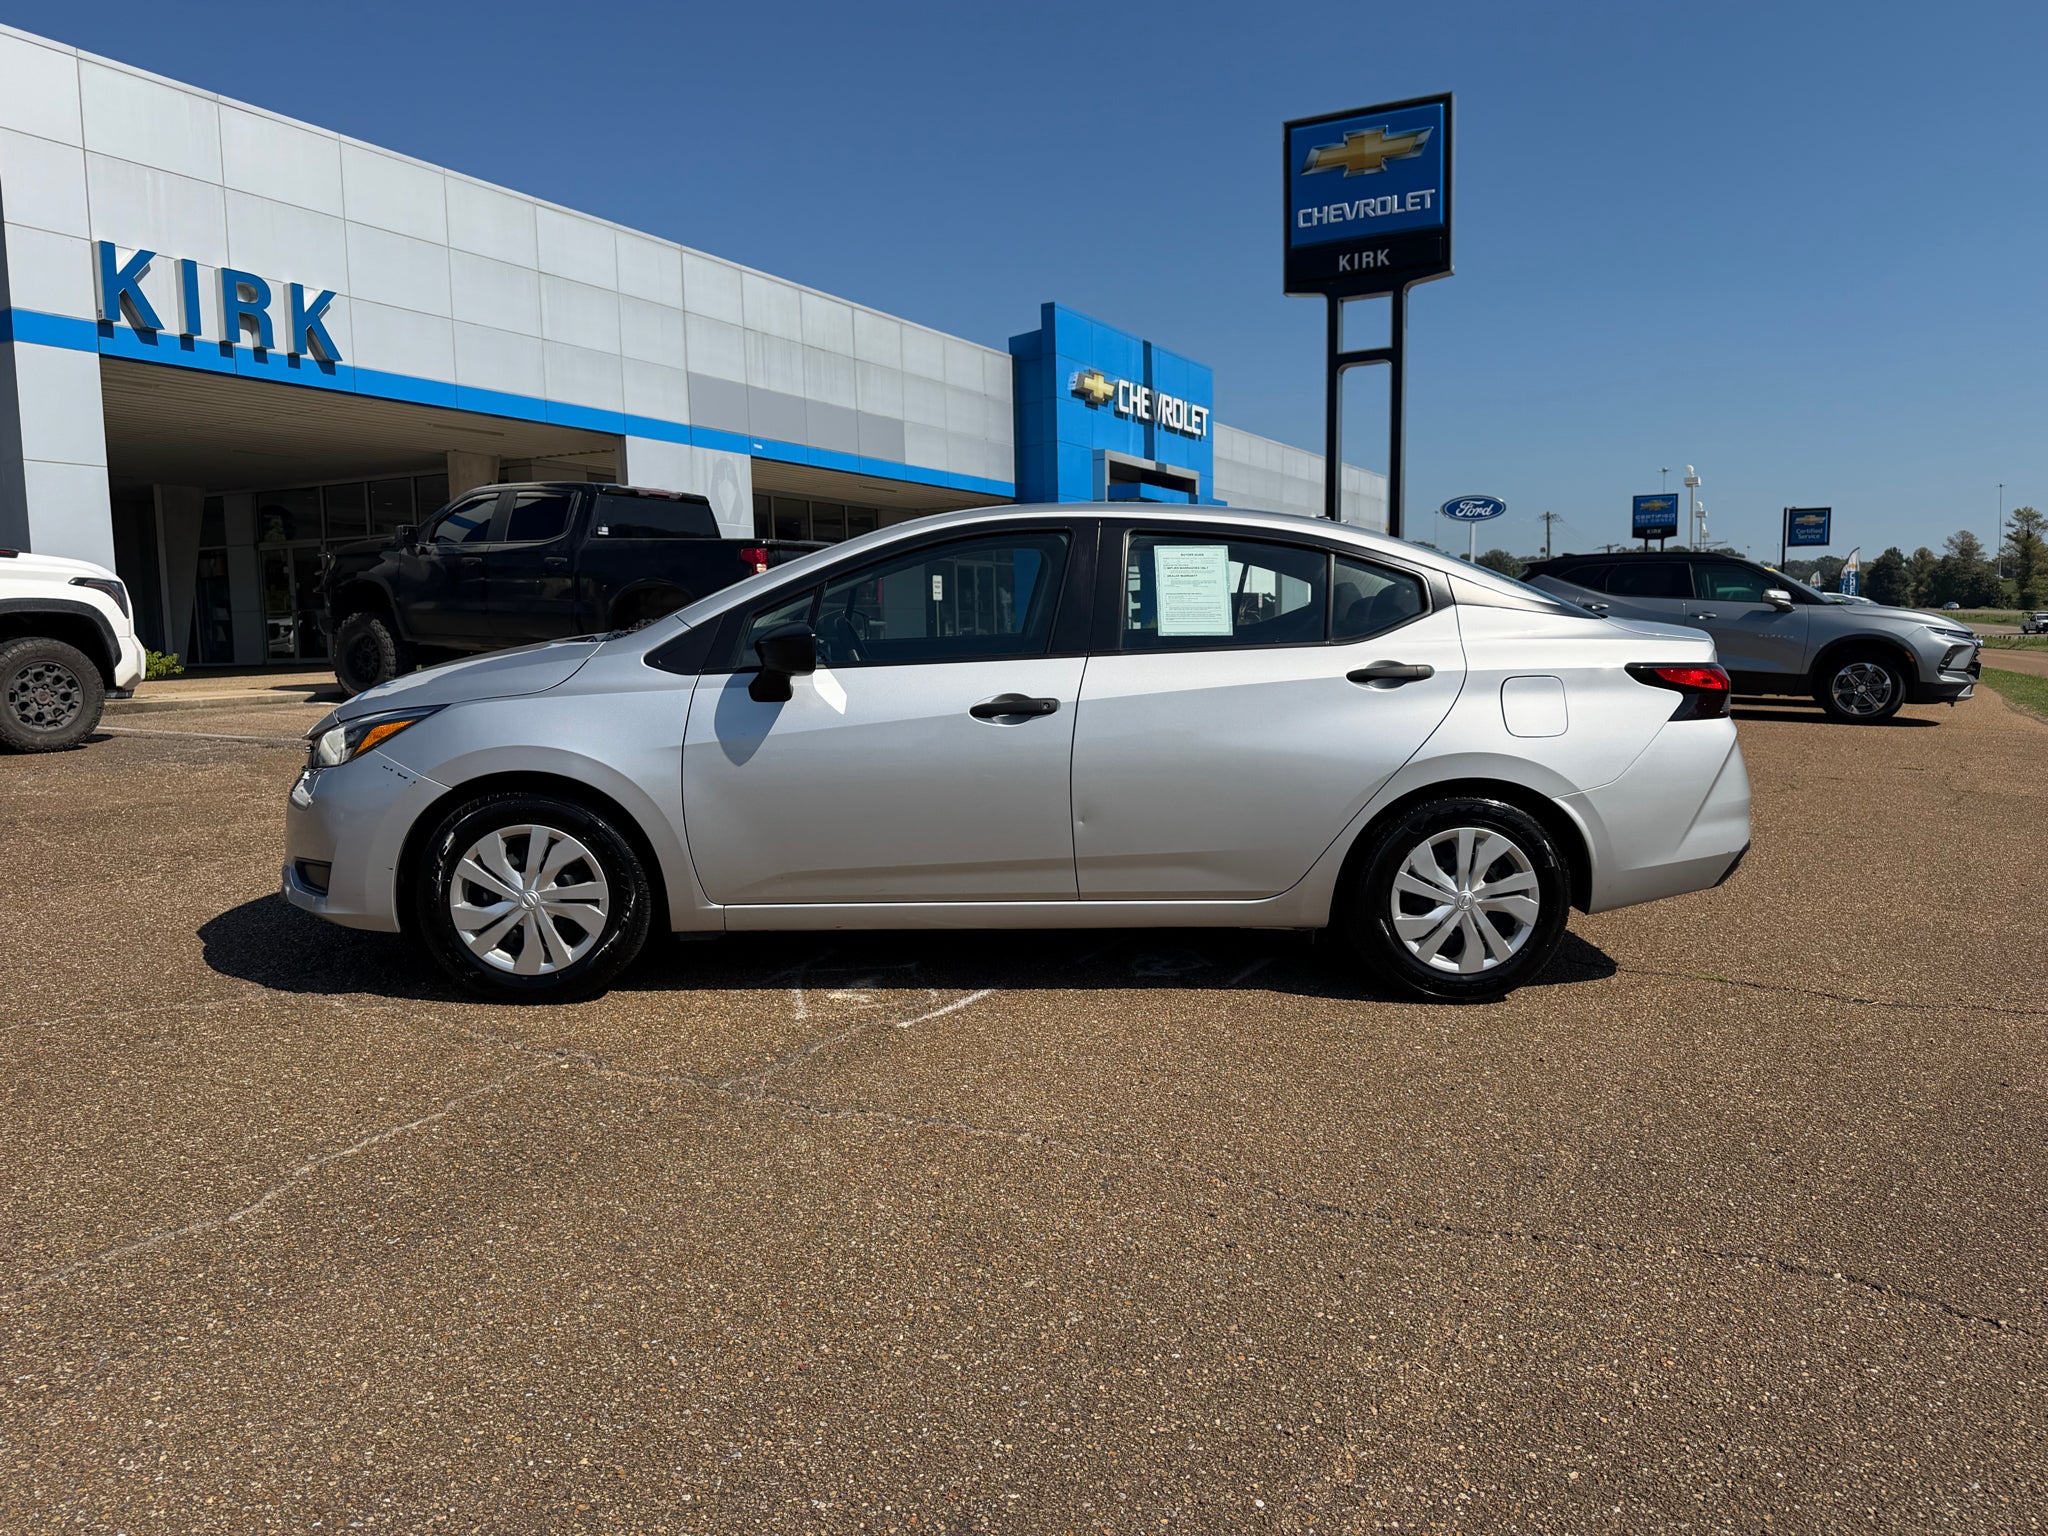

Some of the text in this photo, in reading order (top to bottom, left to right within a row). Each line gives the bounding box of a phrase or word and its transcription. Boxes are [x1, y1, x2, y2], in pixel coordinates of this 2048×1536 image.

[1298, 189, 1435, 228] CHEVROLET
[1338, 249, 1390, 272] KIRK
[94, 240, 343, 362] KIRK
[1117, 379, 1210, 436] CHEVROLET
[1455, 500, 1495, 516] Ford
